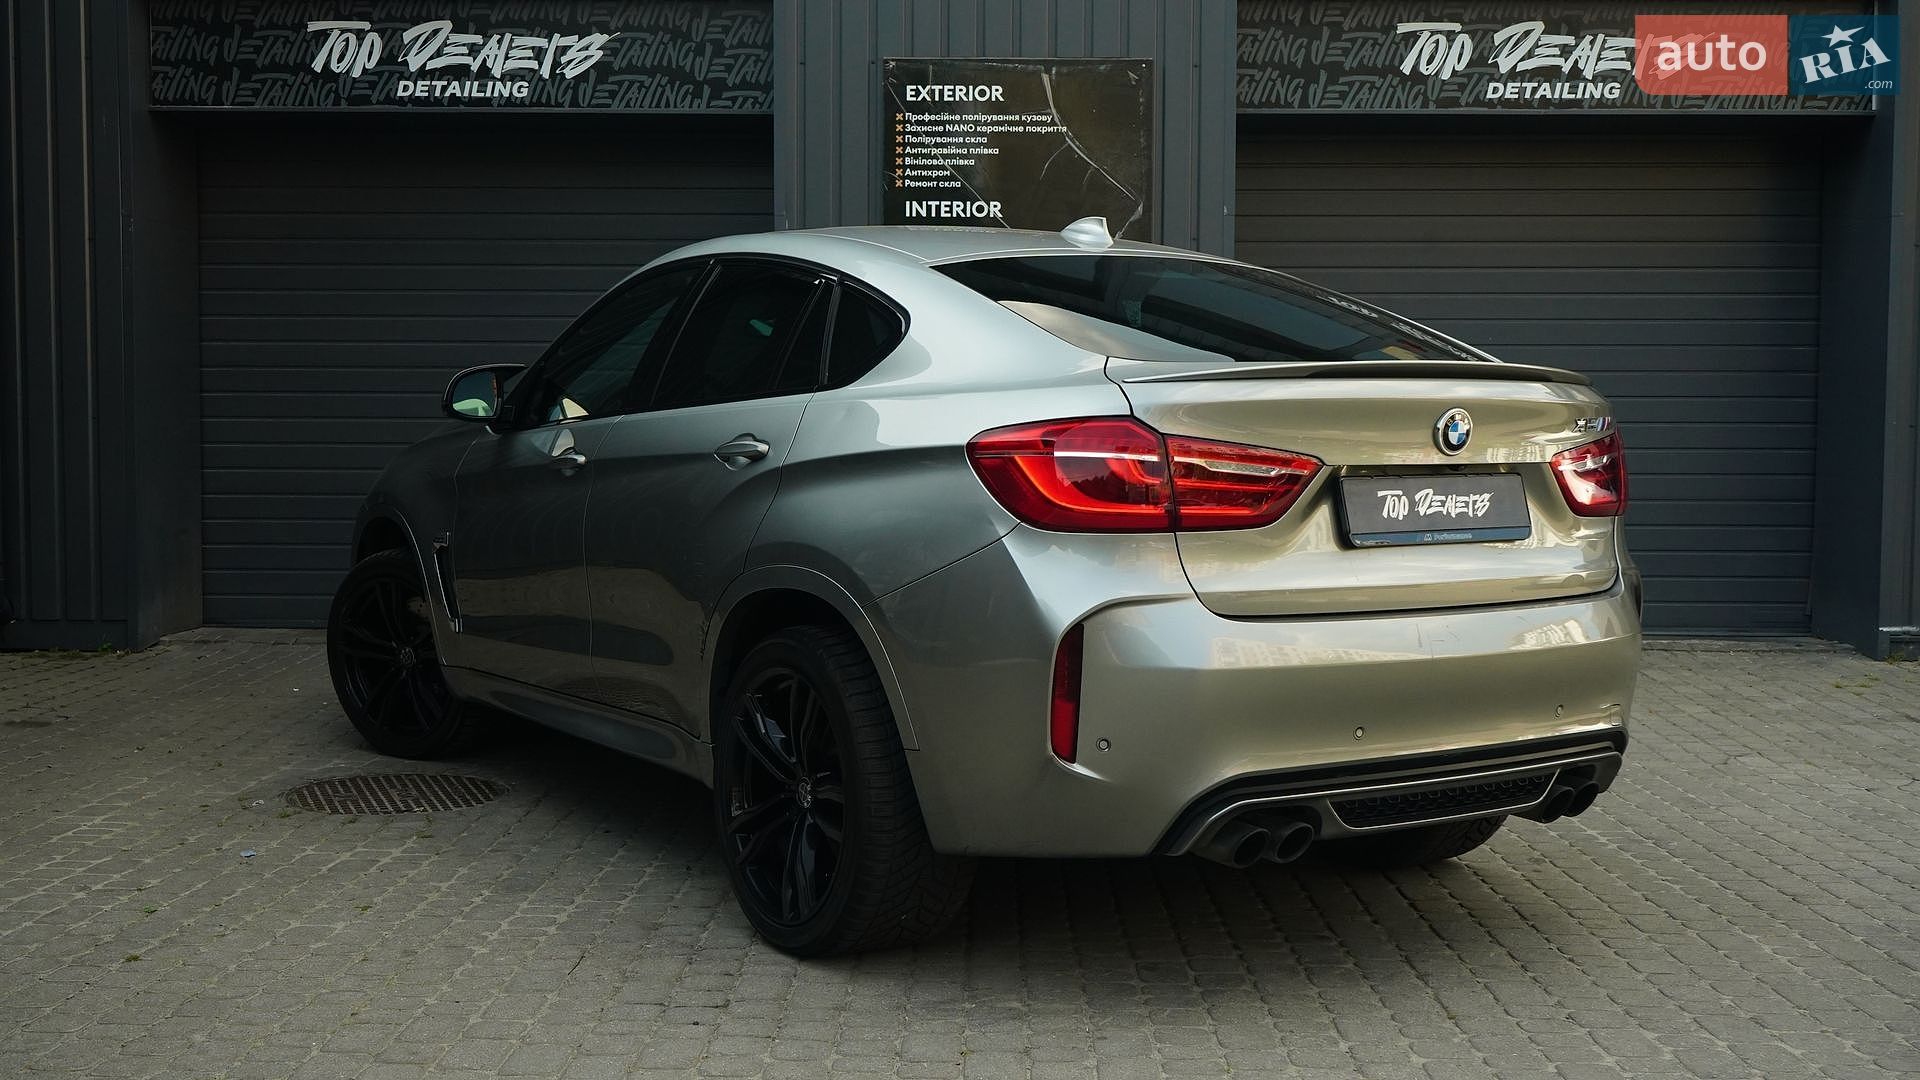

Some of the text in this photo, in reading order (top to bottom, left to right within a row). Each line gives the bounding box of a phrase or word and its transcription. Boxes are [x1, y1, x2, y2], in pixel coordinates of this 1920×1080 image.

[397, 81, 531, 97] DETAILING
[906, 85, 1005, 102] EXTERIOR
[1486, 82, 1622, 99] DETAILING
[905, 112, 1053, 123] Професійне полірування кузову
[905, 124, 1067, 134] Захисне NANO керамічне покриття
[905, 135, 964, 144] Полірування
[905, 146, 999, 156] Антигравійна плівка
[905, 157, 975, 165] Вінілова плівка
[905, 168, 950, 177] Антихром
[905, 180, 961, 188] Ремонт скла
[905, 201, 1003, 217] INTERIOR
